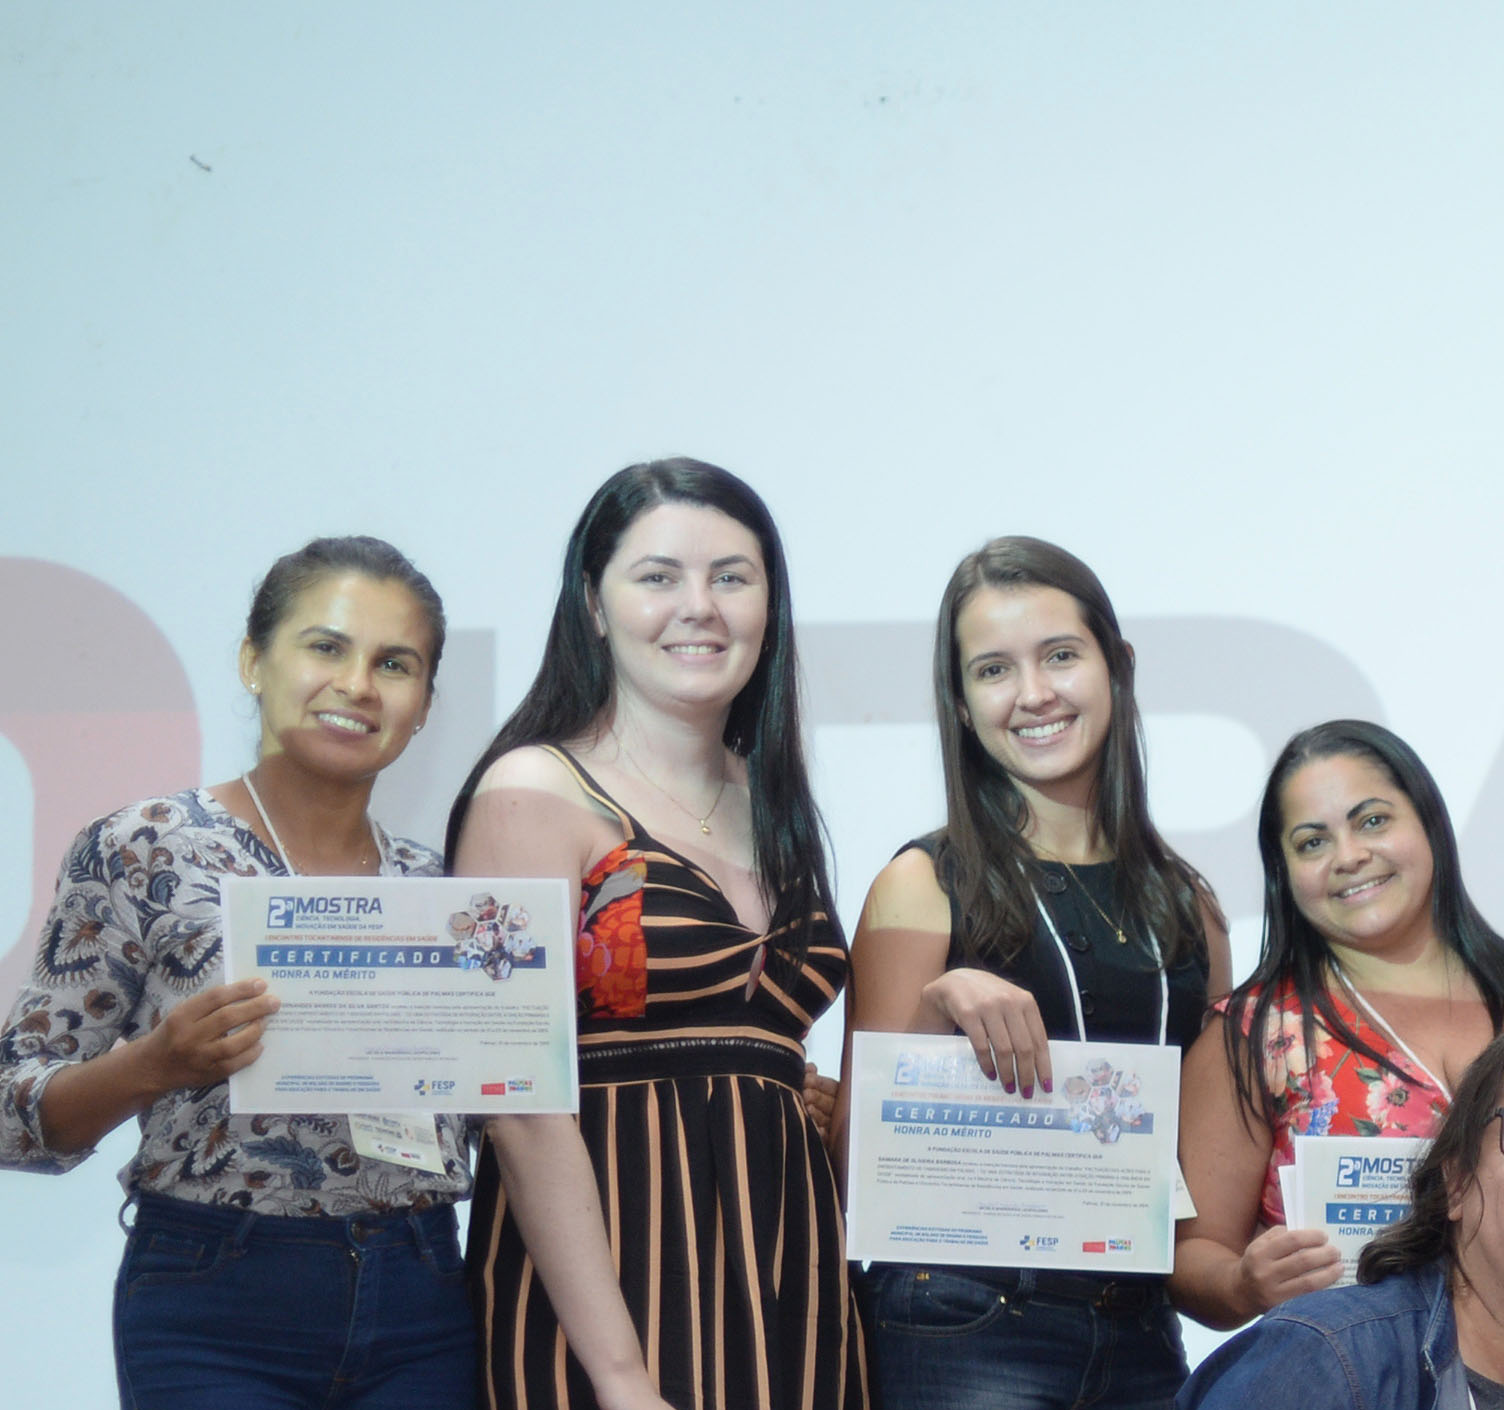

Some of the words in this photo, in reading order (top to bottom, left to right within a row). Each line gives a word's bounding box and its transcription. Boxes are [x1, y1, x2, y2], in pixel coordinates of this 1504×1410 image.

[296, 897, 383, 914] MOSTRA
[271, 951, 441, 963] CERTIFICADO
[271, 970, 310, 979] HONRA
[314, 970, 329, 979] AO
[332, 968, 376, 979] MÉRITO
[431, 1080, 455, 1090] FESP
[894, 1106, 1054, 1125] CERTIFICADO
[893, 1125, 931, 1137] HONRA
[933, 1127, 948, 1137] AO
[950, 1124, 992, 1139] MÉRITO
[1362, 1158, 1416, 1173] MOST
[1338, 1208, 1404, 1221] CERTI
[1338, 1226, 1374, 1236] HONRA
[1036, 1236, 1059, 1247] FESP
